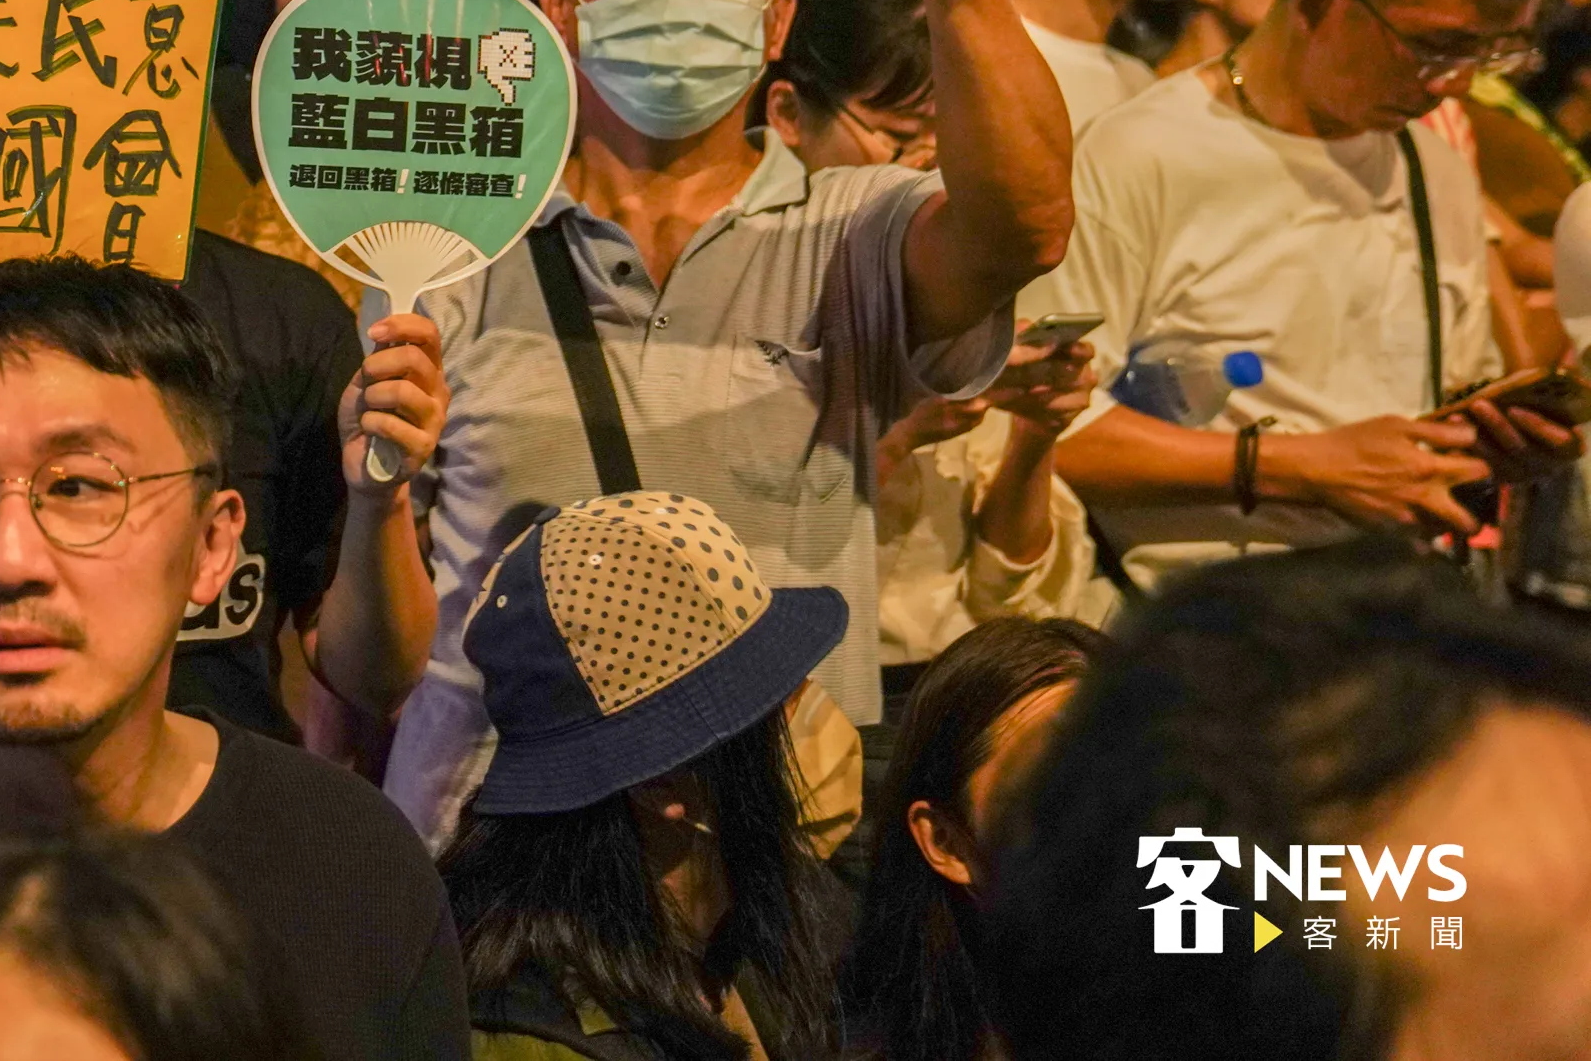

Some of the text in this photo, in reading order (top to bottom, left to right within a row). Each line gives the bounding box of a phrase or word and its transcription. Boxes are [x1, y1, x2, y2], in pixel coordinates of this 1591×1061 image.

[291, 26, 473, 90] 我藐視
[288, 92, 524, 159] 藍白黑箱
